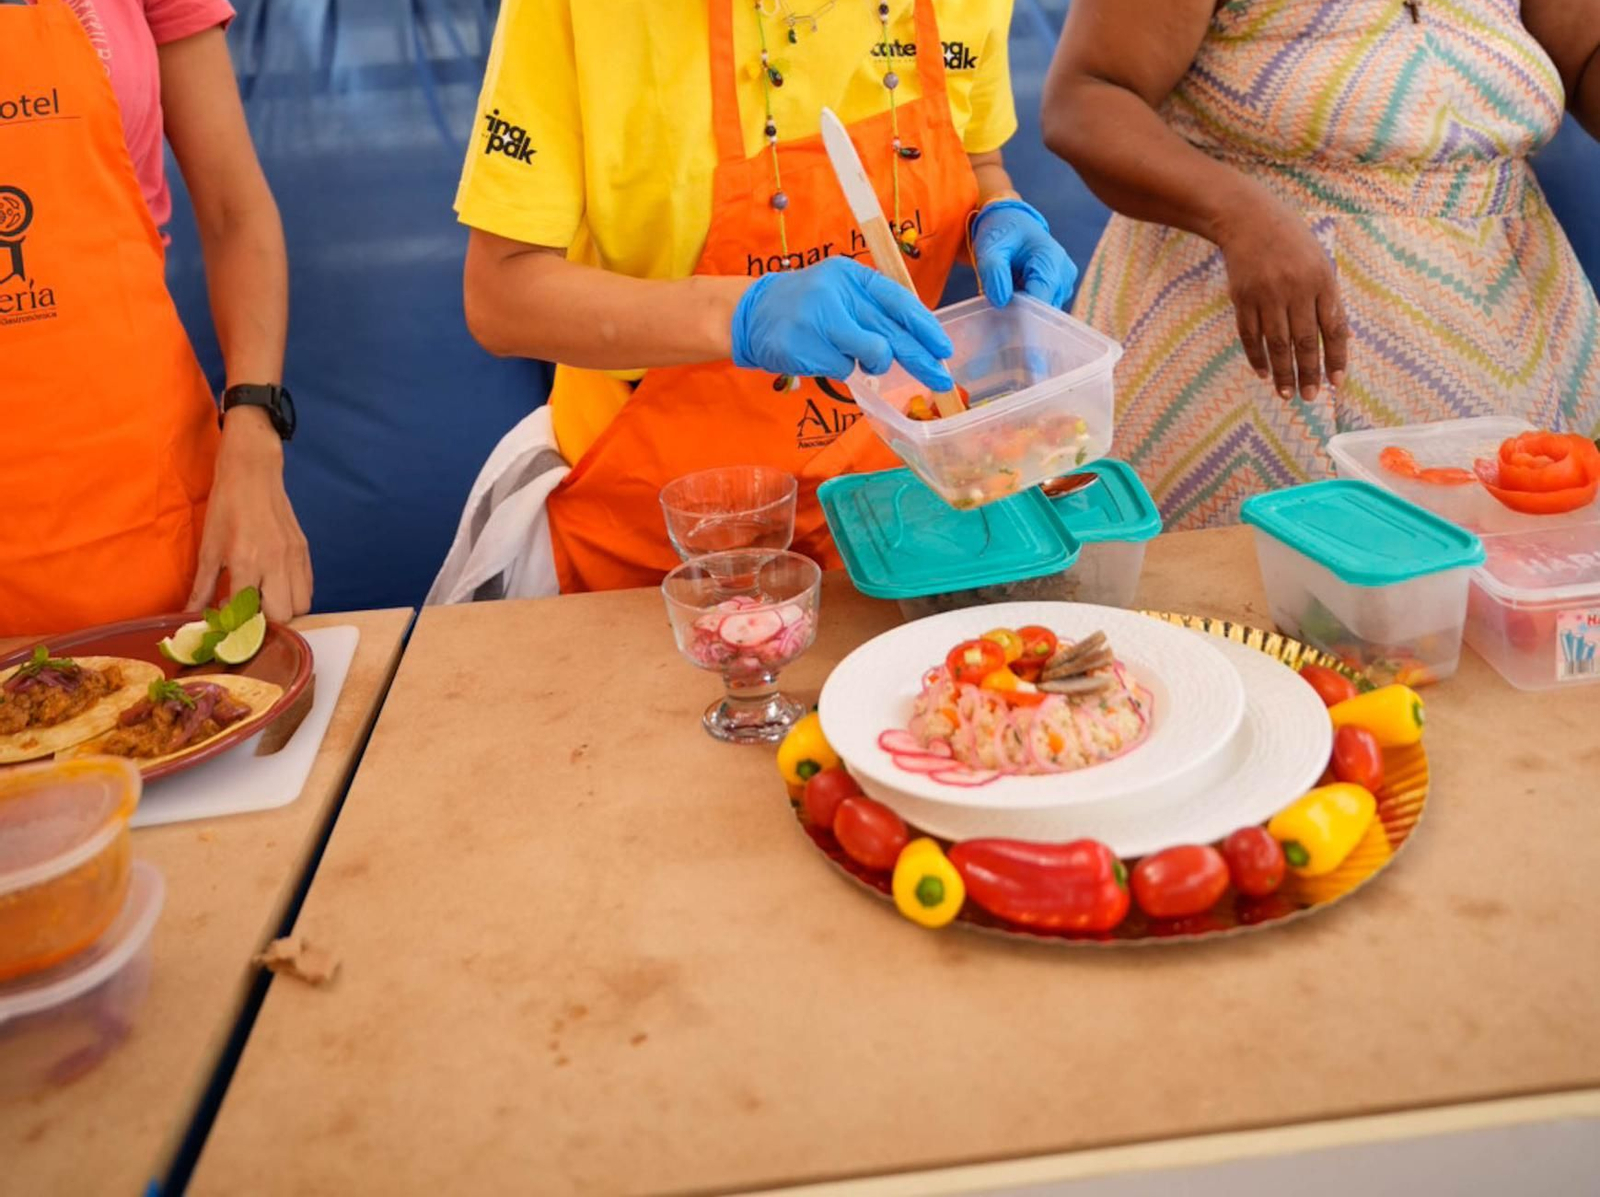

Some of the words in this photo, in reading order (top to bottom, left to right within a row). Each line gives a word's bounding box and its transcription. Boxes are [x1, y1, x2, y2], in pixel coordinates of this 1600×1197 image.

[0, 88, 59, 119] otel
[485, 135, 537, 165] pak
[747, 242, 834, 276] hogar
[852, 209, 922, 250] htel
[0, 278, 56, 313] ería
